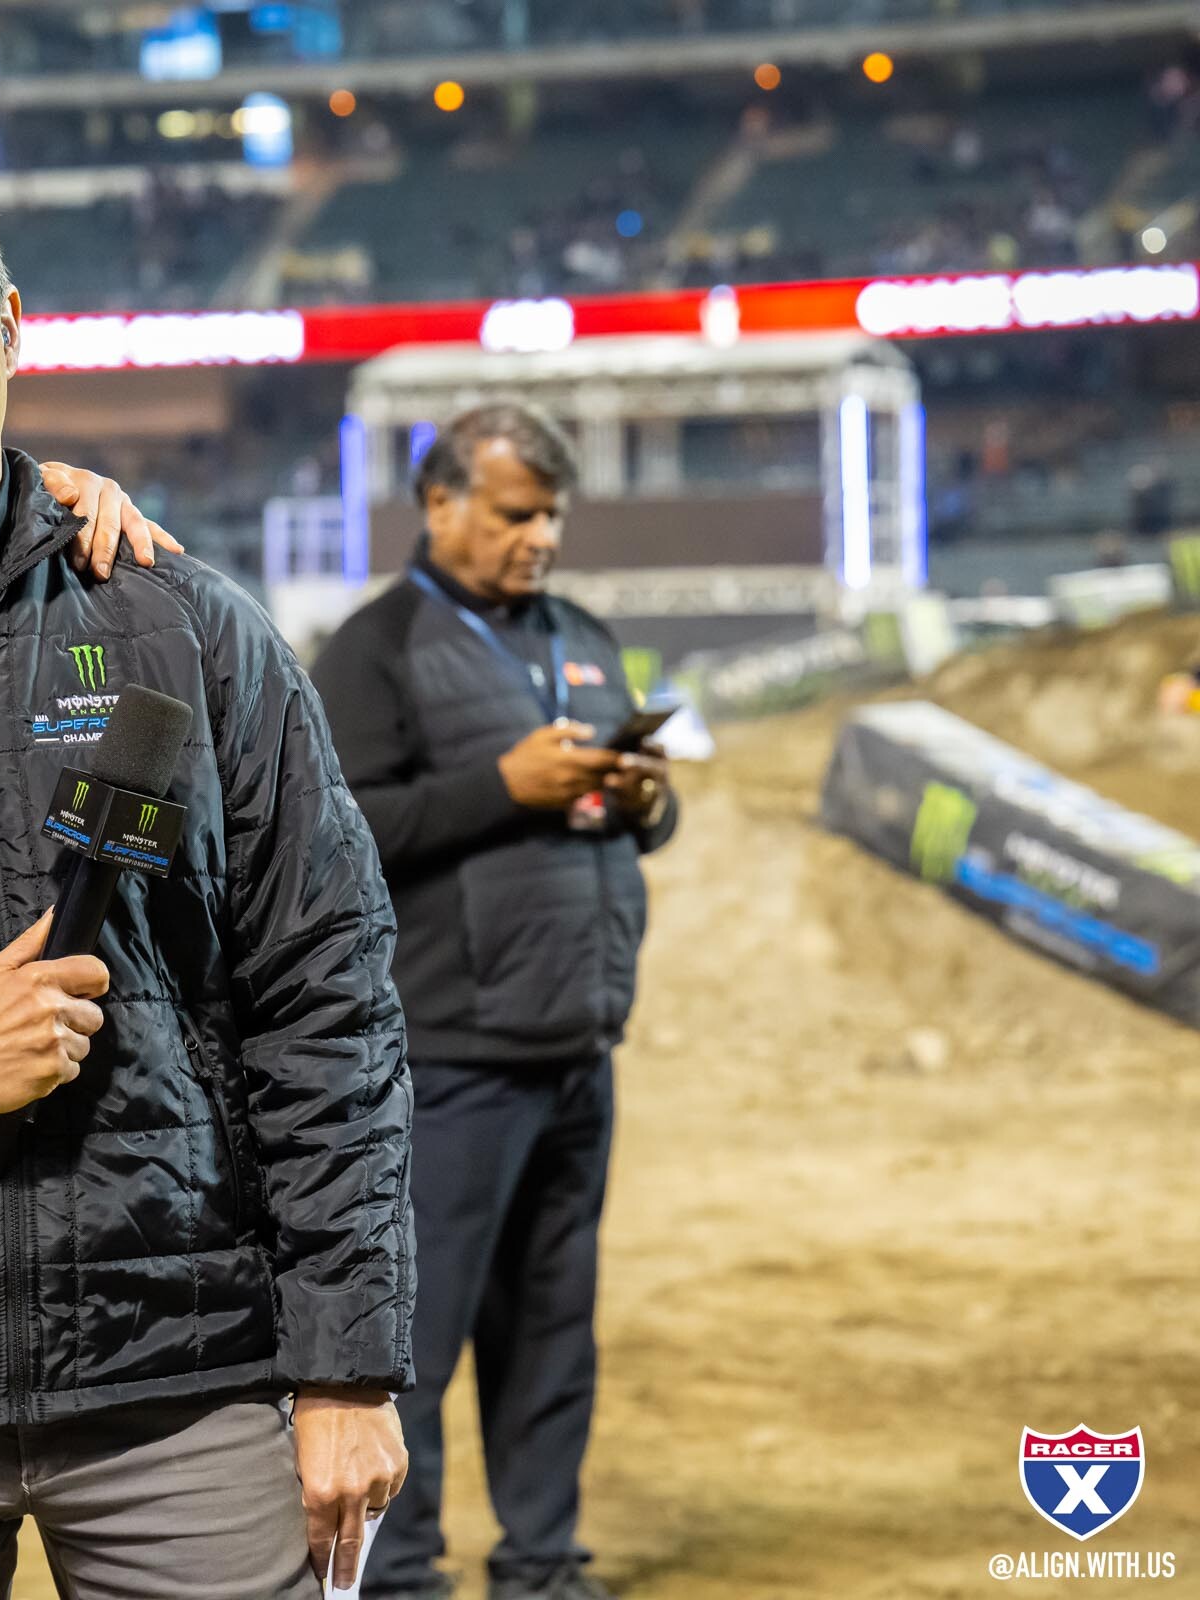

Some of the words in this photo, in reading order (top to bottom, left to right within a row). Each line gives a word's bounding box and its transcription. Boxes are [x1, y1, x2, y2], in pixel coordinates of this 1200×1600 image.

[56, 694, 120, 710] MONSTE
[70, 707, 115, 716] ENERG
[32, 717, 110, 733] SUPERC
[62, 732, 104, 743] CHAMP
[122, 833, 158, 848] MONSTER
[102, 843, 169, 866] SUPERCROSS
